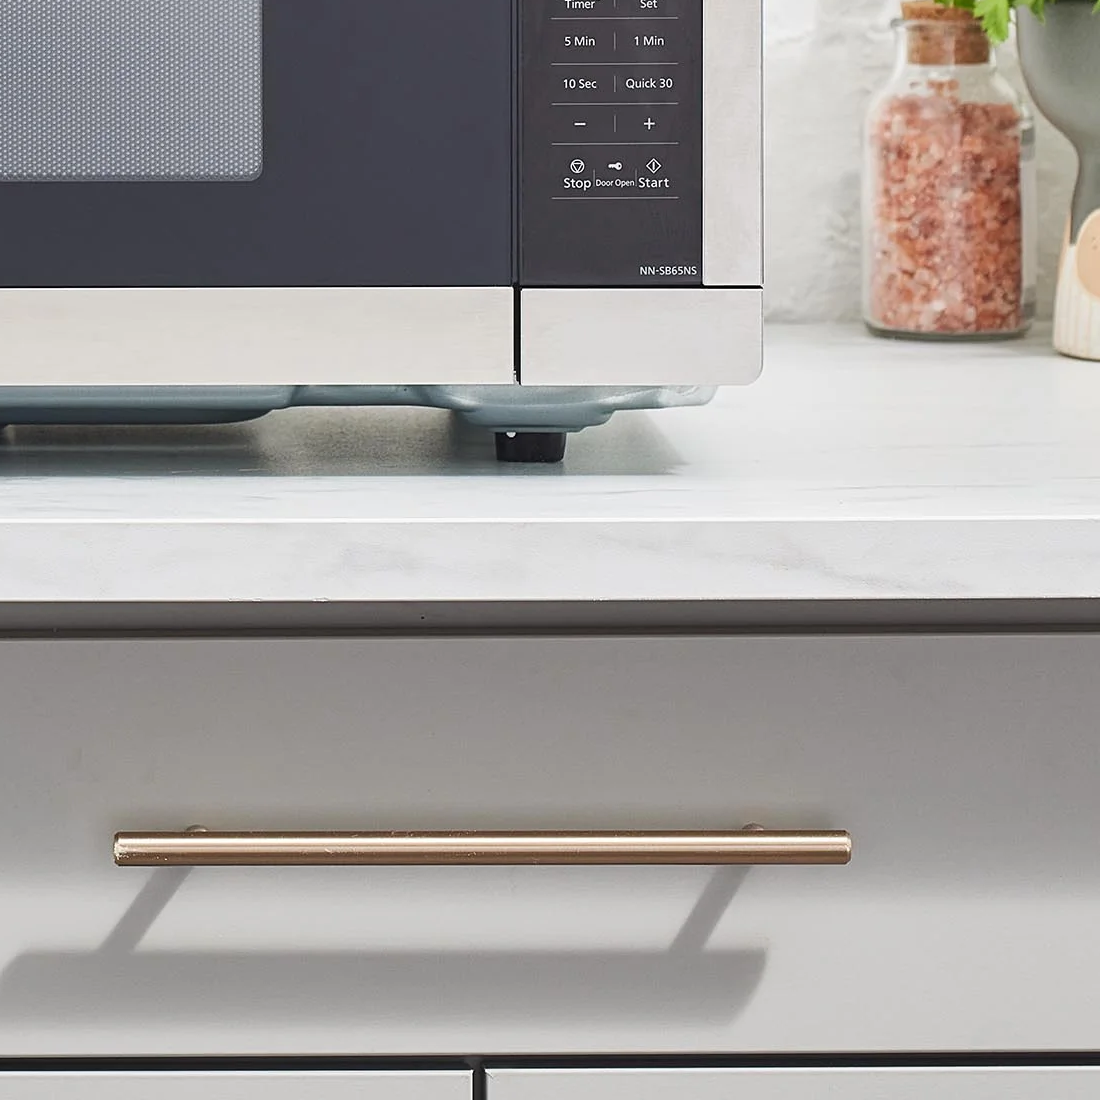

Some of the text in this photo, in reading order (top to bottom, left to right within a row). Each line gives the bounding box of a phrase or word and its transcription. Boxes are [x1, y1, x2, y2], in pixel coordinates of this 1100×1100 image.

[565, 0, 596, 9] Timer
[564, 35, 596, 47] 5 Min
[643, 35, 665, 46] Min
[563, 78, 597, 89] 10 Sec
[625, 77, 673, 90] Quick 30
[563, 177, 592, 192] Stop
[595, 178, 635, 188] Door Open
[638, 177, 670, 189] Start
[639, 265, 698, 276] NN-SB65NS
